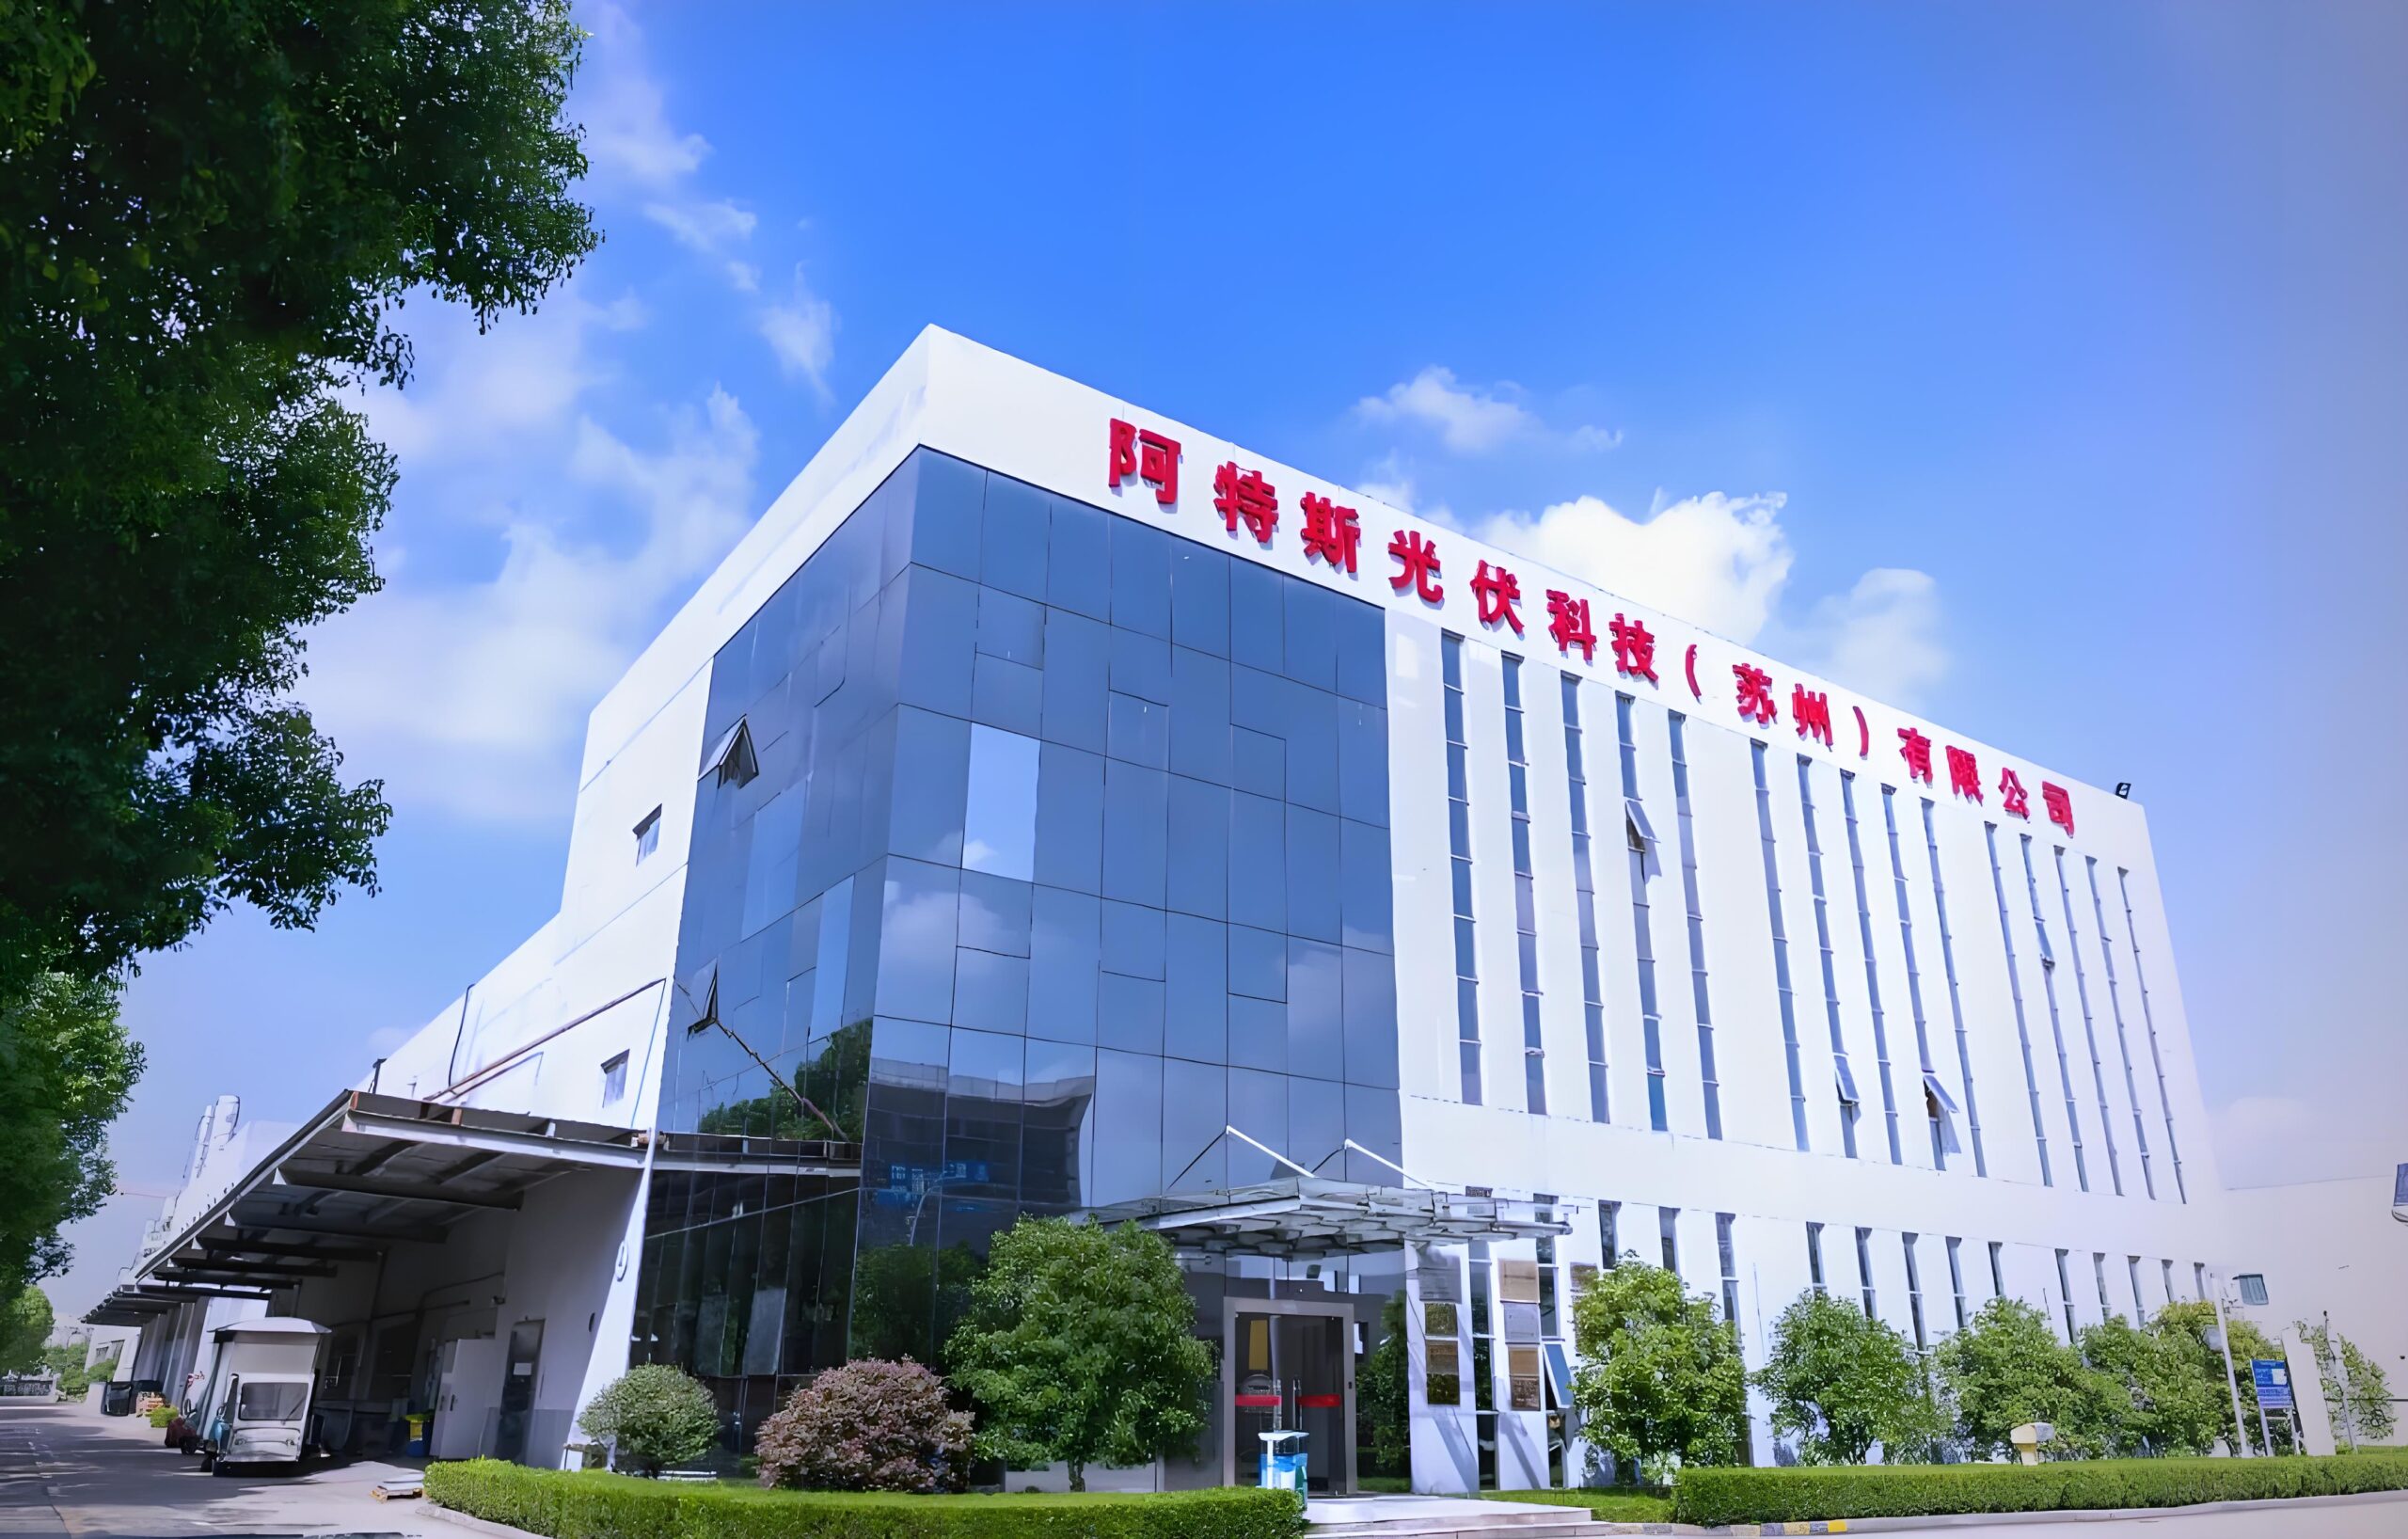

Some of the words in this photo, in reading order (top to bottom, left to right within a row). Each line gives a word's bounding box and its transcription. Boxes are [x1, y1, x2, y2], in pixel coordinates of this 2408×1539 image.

[1109, 418, 2075, 835] 阿特斯光伏科技（苏州）有限公司
